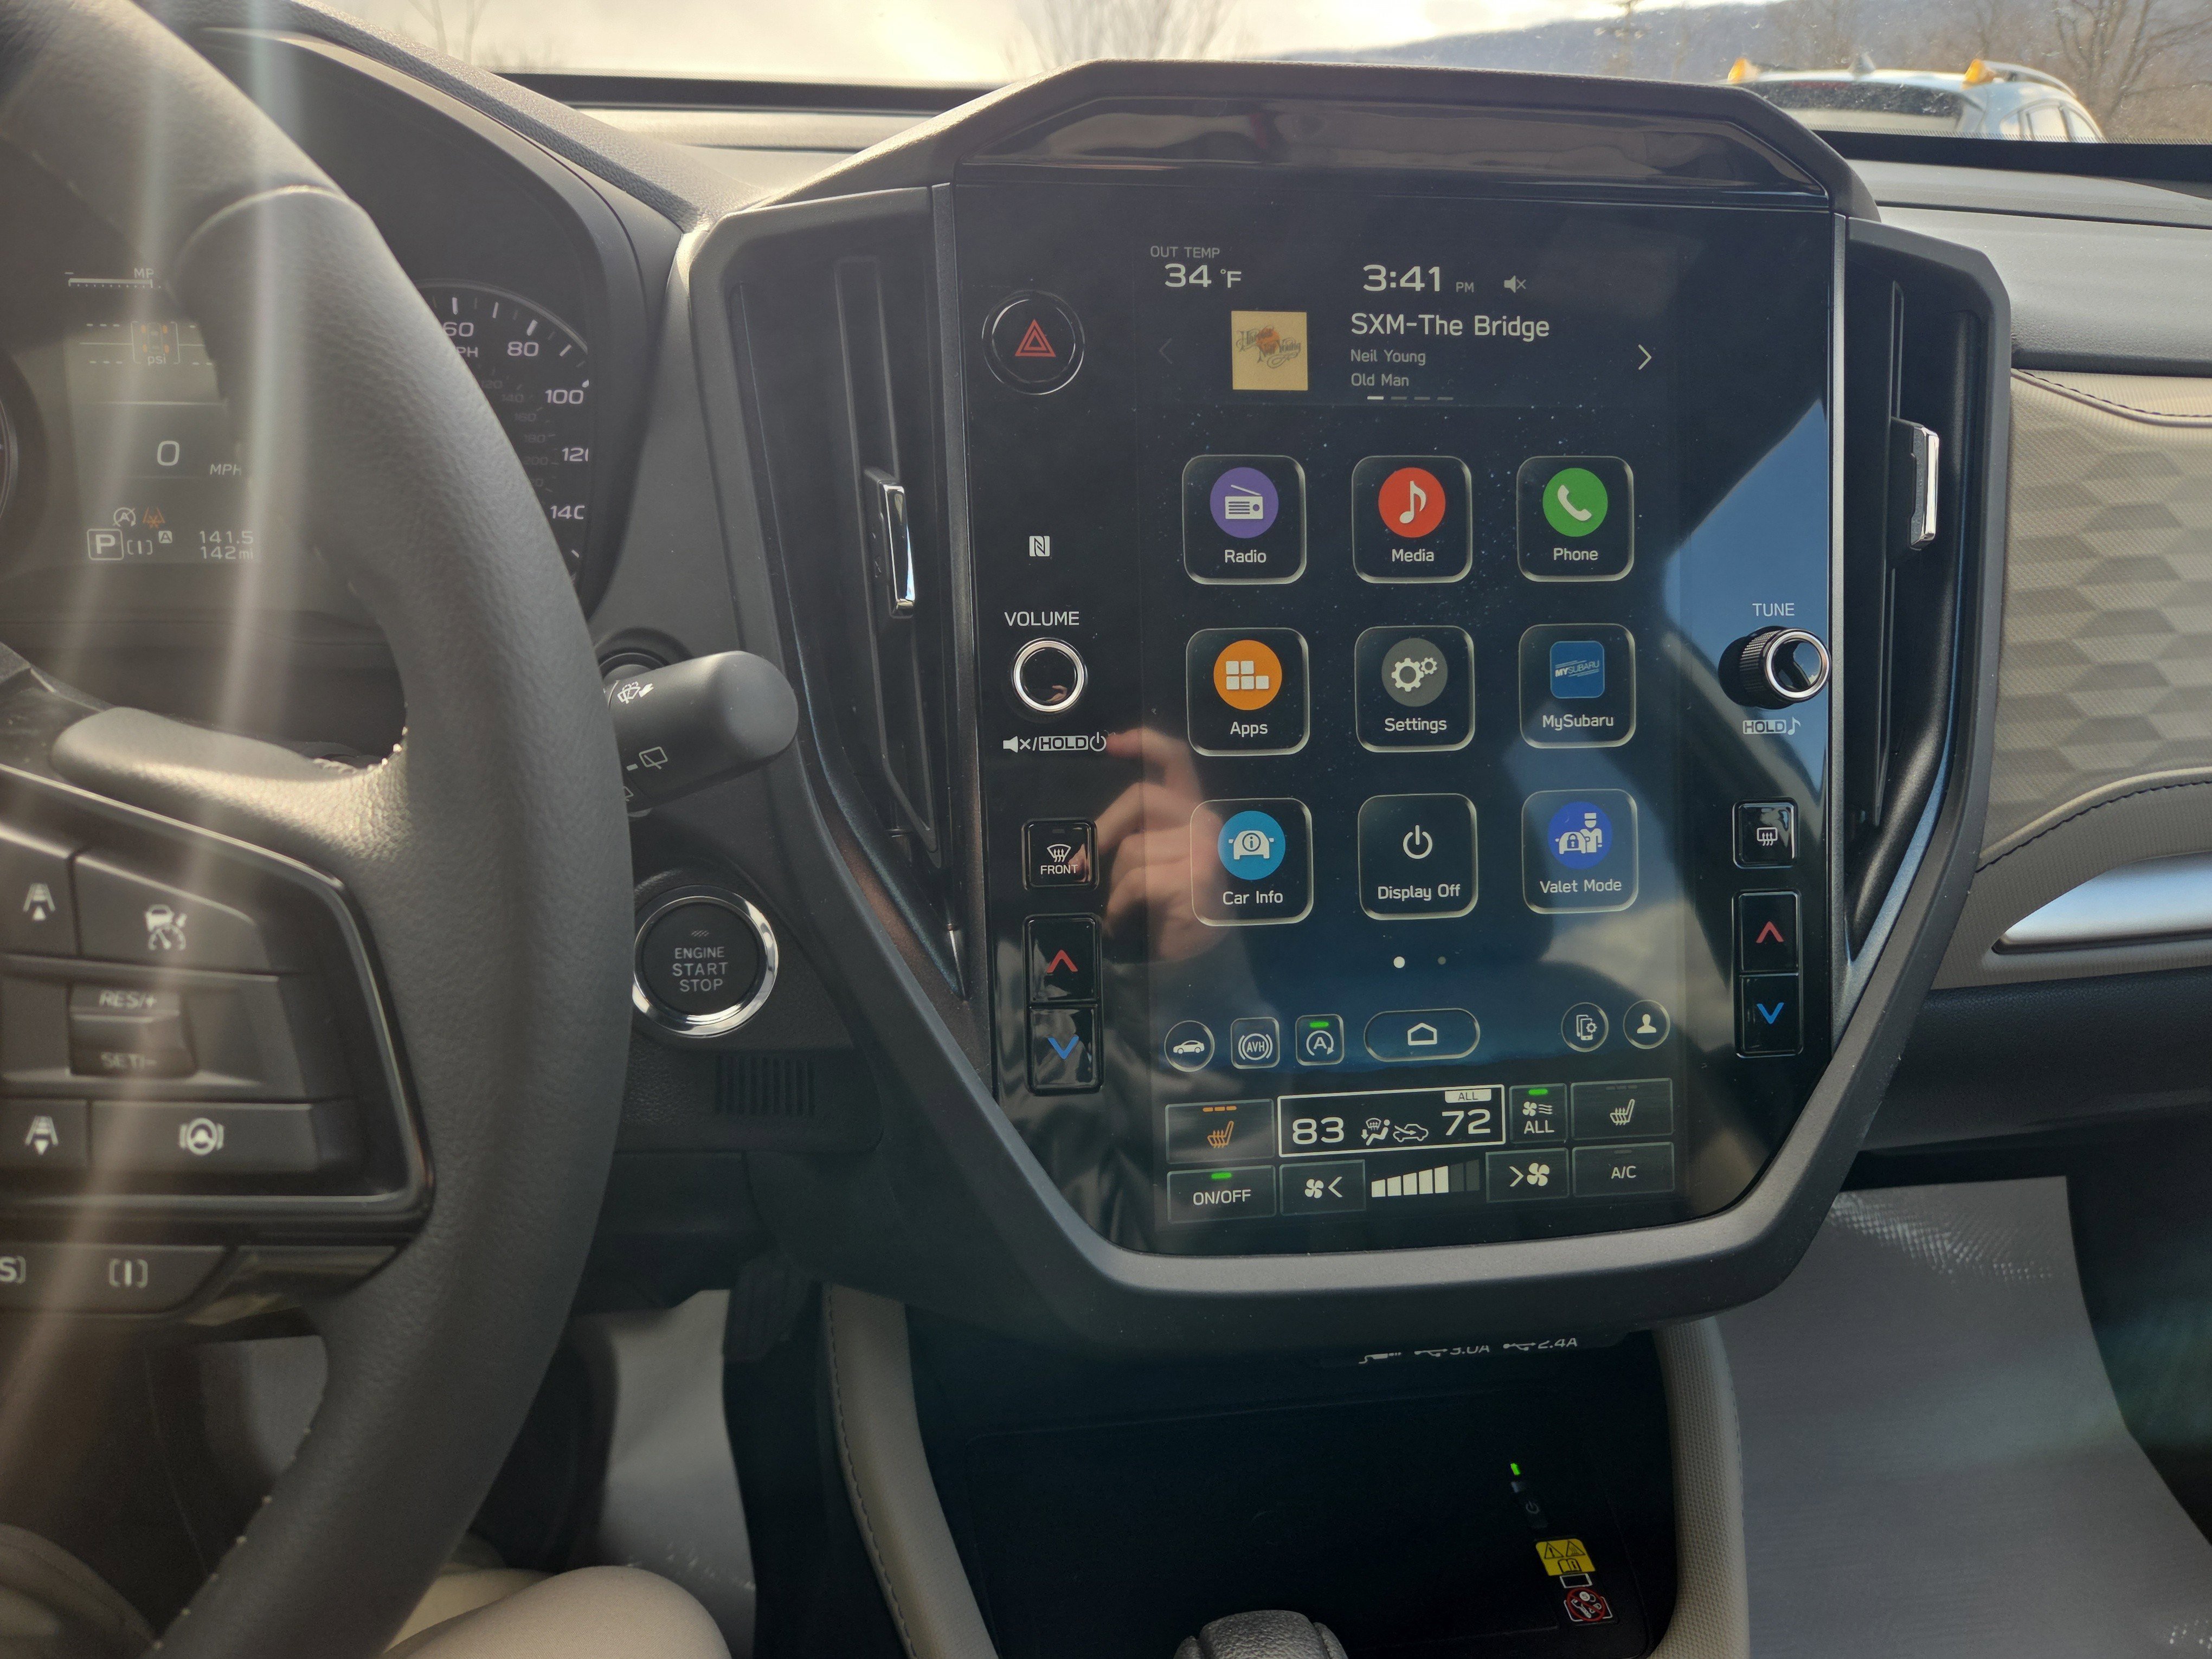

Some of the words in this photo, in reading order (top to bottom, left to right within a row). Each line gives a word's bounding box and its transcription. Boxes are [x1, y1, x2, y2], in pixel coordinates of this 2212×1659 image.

[1149, 245, 1179, 258] OUT
[1183, 246, 1220, 259] TEMP
[134, 268, 155, 279] MP
[1165, 263, 1212, 288] 34
[1363, 264, 1440, 292] 3:41
[1456, 281, 1474, 293] PM
[442, 322, 474, 337] 60
[1351, 313, 1463, 337] SXM-The
[1474, 315, 1549, 342] Bridge
[455, 346, 478, 358] PH
[507, 341, 539, 357] 80
[147, 353, 167, 366] psi
[1351, 349, 1378, 362] Neil
[1384, 349, 1426, 366] Young
[1351, 372, 1375, 387] Old
[1381, 373, 1409, 387] Man
[545, 389, 584, 404] 100
[156, 440, 180, 466] 0
[210, 464, 242, 476] MPH
[95, 534, 115, 554] P
[199, 530, 254, 544] 141.5
[1224, 549, 1267, 563] Radio
[1392, 548, 1435, 562] Media
[1553, 547, 1599, 561] Phone
[1752, 602, 1795, 617] TUNE
[1004, 611, 1079, 627] VOLUME
[1385, 717, 1448, 734] Settings
[1542, 713, 1614, 730] MySubaru
[1744, 721, 1785, 733] HOLD
[1230, 721, 1268, 738] Apps
[1040, 864, 1079, 875] FRONT
[1378, 885, 1432, 902] Display
[1437, 883, 1461, 898] Off
[1540, 879, 1578, 893] Valet
[1584, 878, 1622, 892] Mode
[1222, 890, 1250, 906] Car
[1256, 890, 1283, 904] Info
[674, 946, 724, 959] ENGINE
[672, 962, 728, 977] START
[679, 978, 723, 993] STOP
[1246, 1041, 1265, 1053] AVH
[1292, 1116, 1345, 1145] 83
[1457, 1091, 1479, 1101] ALL
[1442, 1109, 1491, 1136] 72
[1523, 1119, 1555, 1134] ALL
[1611, 1165, 1636, 1179] A/C
[1193, 1189, 1251, 1206] ON/OFF
[1538, 1338, 1578, 1349] 2.4A
